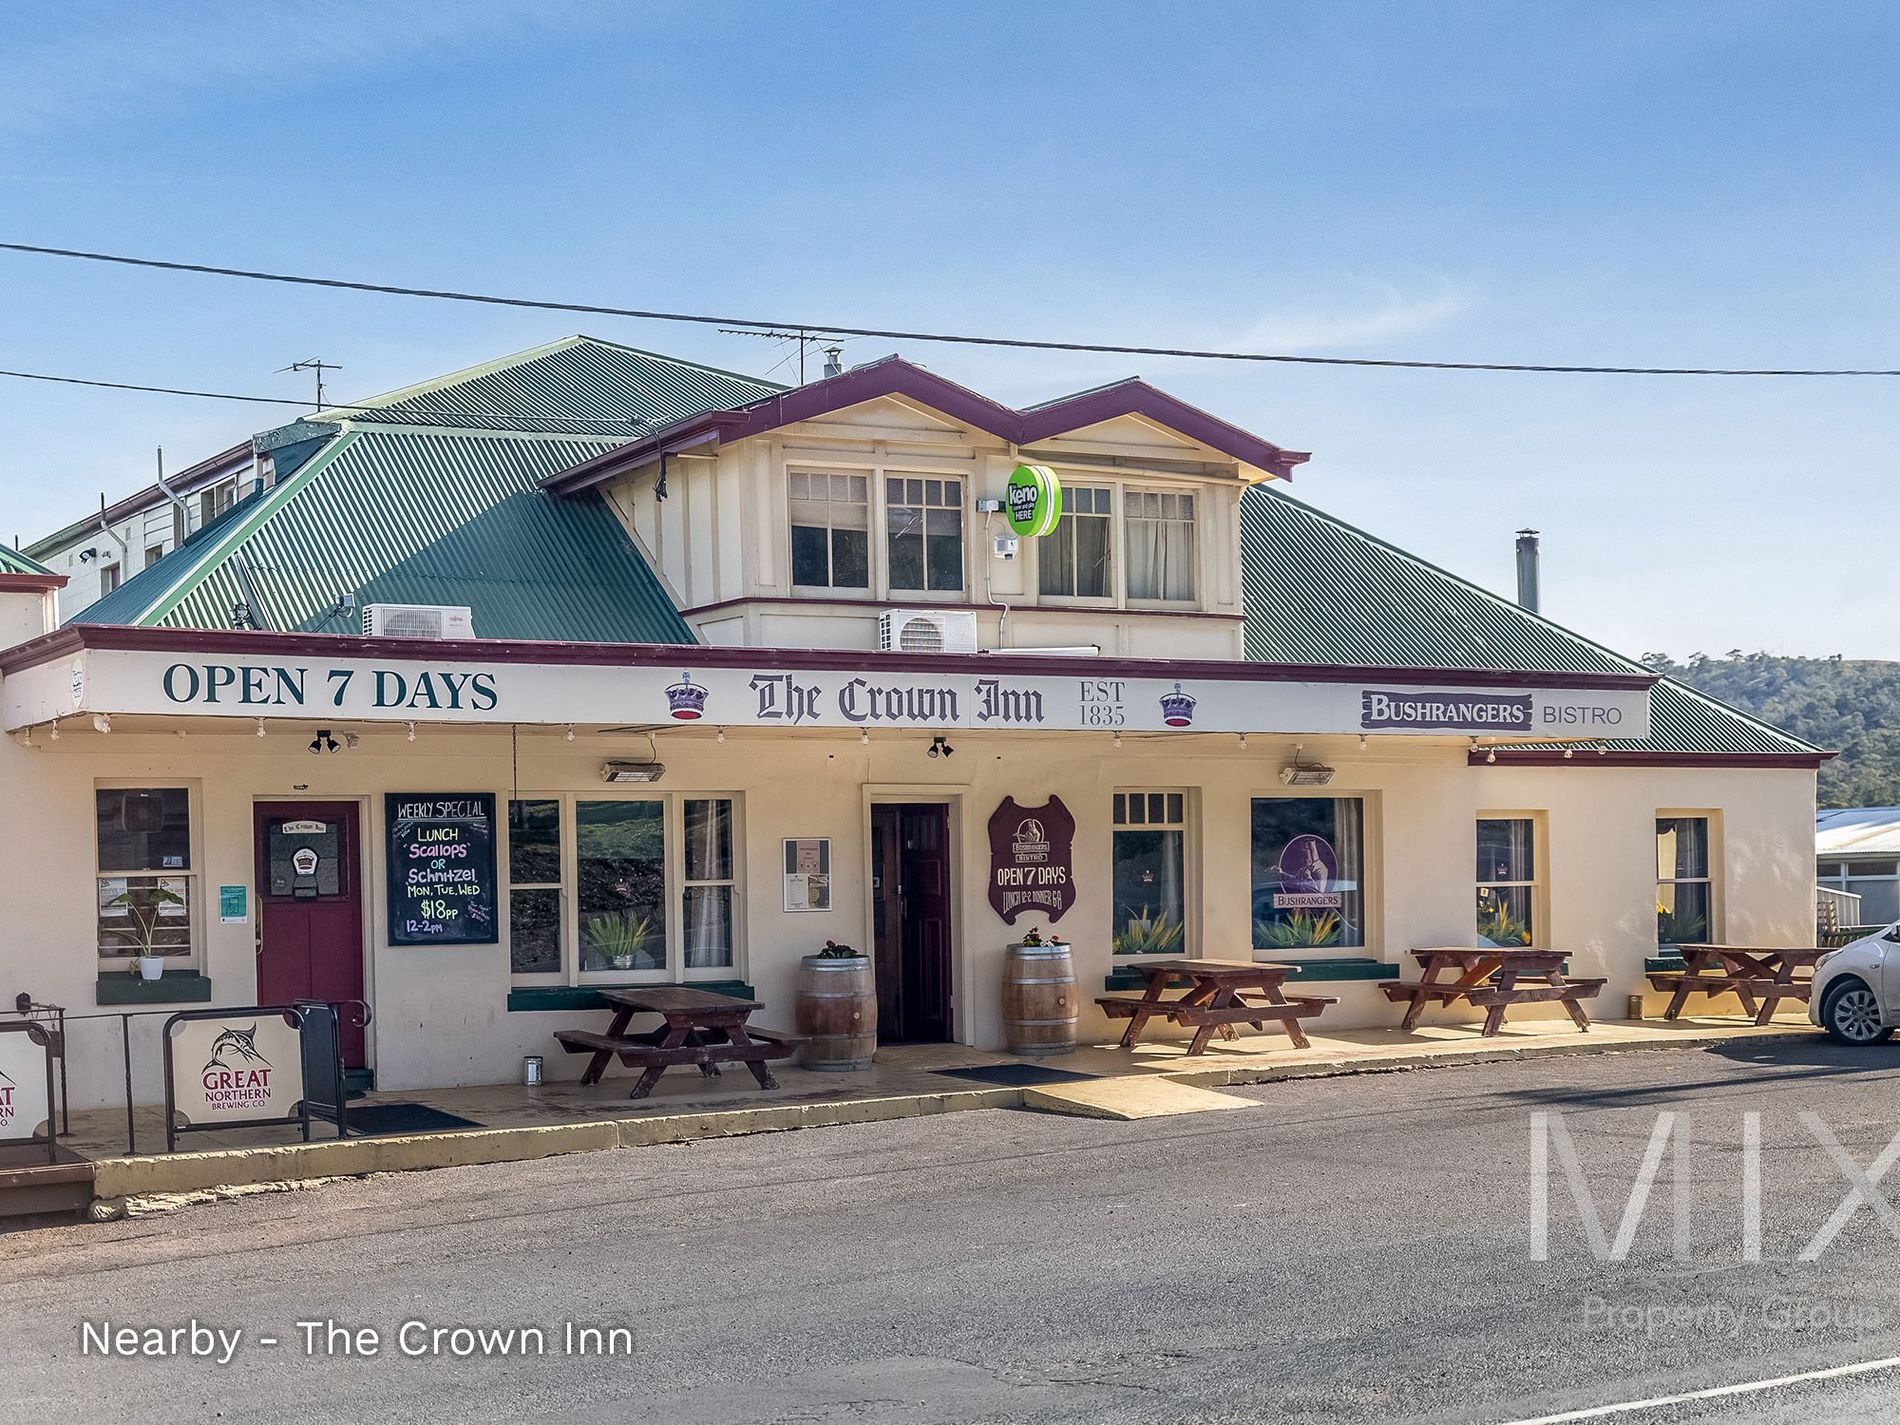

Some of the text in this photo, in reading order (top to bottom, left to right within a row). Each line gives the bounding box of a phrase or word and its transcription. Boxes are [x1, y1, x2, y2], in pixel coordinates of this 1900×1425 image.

[1009, 485, 1037, 505] keno
[1015, 510, 1032, 520] HERE
[162, 663, 498, 711] OPEN 7 DAYS
[1079, 681, 1126, 702] EST
[749, 674, 1045, 725] The Crown Inn
[1370, 694, 1623, 725] BUSHRANGERS BISTRO
[1079, 705, 1125, 726] 1835
[397, 801, 485, 819] WEEKLY SPECIAL
[418, 828, 458, 841] LUNCH
[431, 858, 446, 870] OR
[997, 866, 1066, 886] OPEN 7 DAYS
[1003, 891, 1021, 914] LUNCH
[1021, 891, 1032, 904] 12-2
[1032, 890, 1052, 905] DINNER
[1277, 895, 1339, 906] BUSHRANGERS
[202, 1069, 272, 1090] GREAT
[205, 1088, 271, 1102] NORTHERN
[212, 1099, 267, 1110] BREWING CO.
